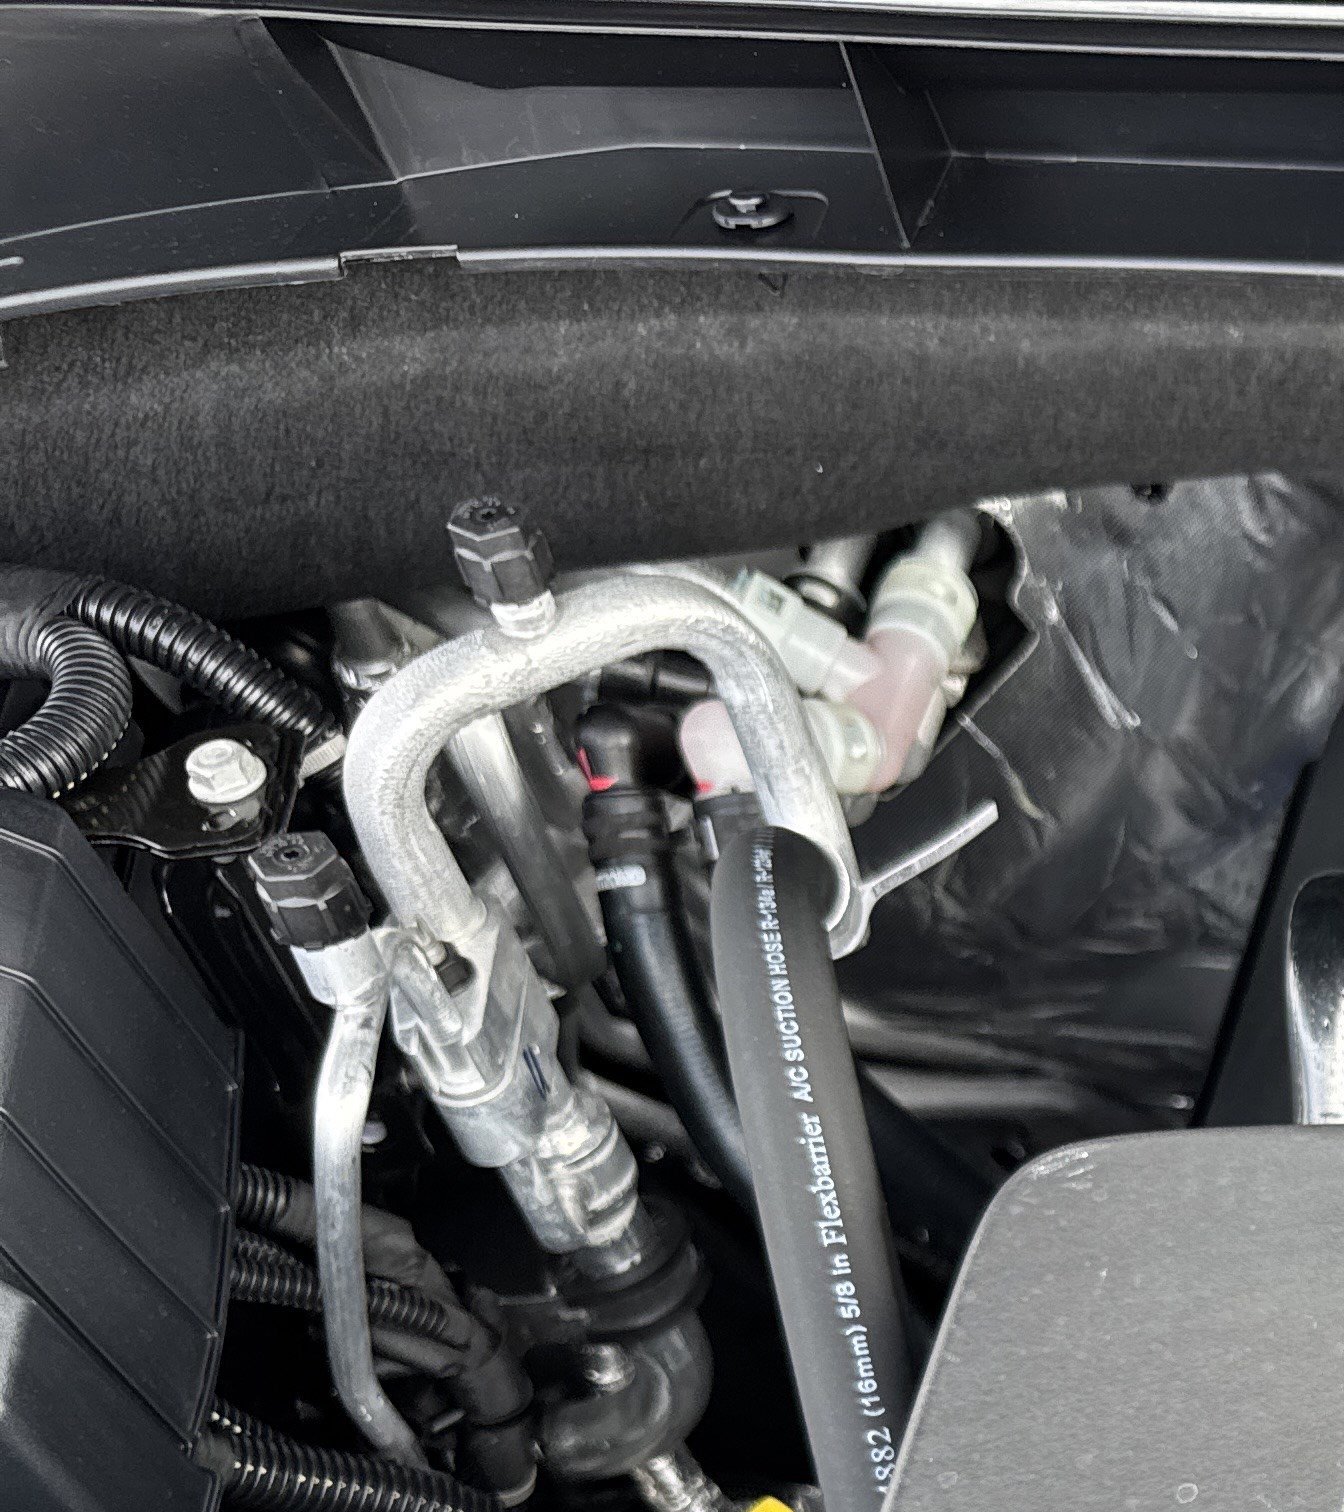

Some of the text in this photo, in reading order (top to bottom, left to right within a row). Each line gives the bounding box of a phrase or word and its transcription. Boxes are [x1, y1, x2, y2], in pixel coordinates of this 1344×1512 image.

[761, 931, 788, 976] HOSE
[771, 976, 805, 1062] SUCTION
[788, 1065, 814, 1103] A/C
[799, 1111, 848, 1248] Flexbarrier
[837, 1281, 861, 1319] 5/8
[845, 1323, 886, 1417] (16mm)
